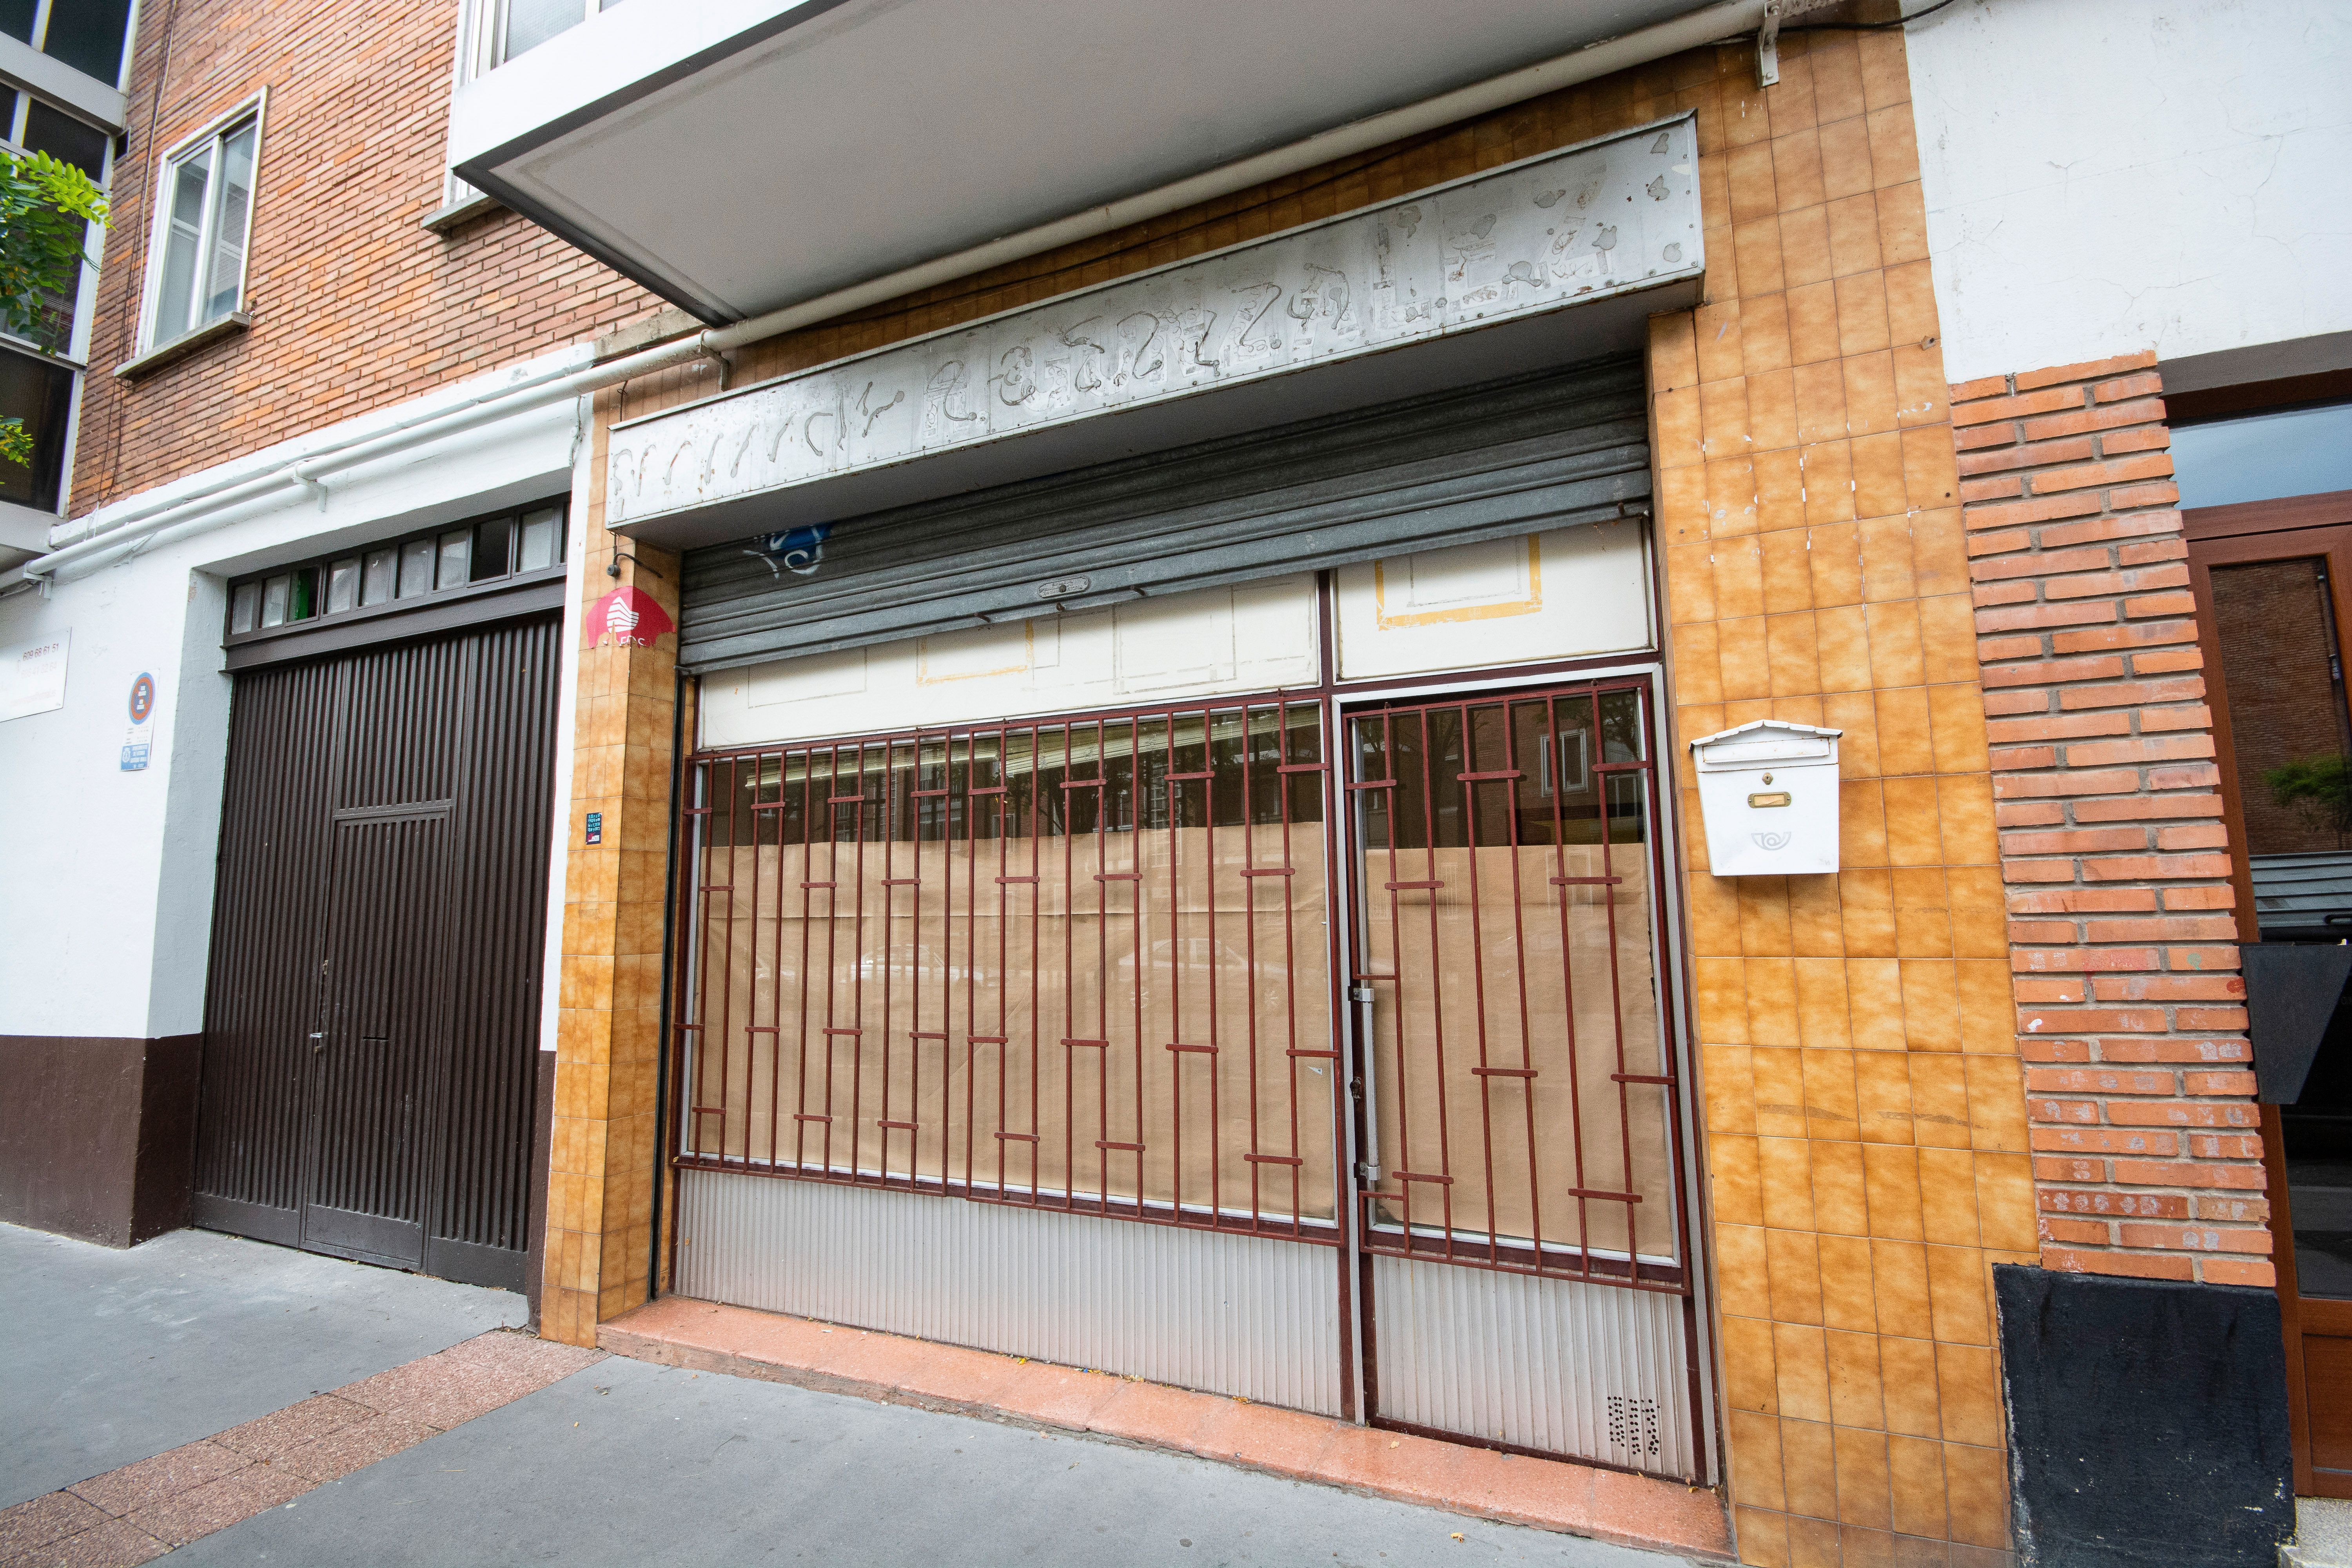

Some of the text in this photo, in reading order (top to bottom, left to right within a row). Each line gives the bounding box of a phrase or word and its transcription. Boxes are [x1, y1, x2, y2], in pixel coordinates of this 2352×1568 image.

[23, 650, 34, 661] 609
[43, 645, 50, 655] 61
[52, 643, 59, 652] 51
